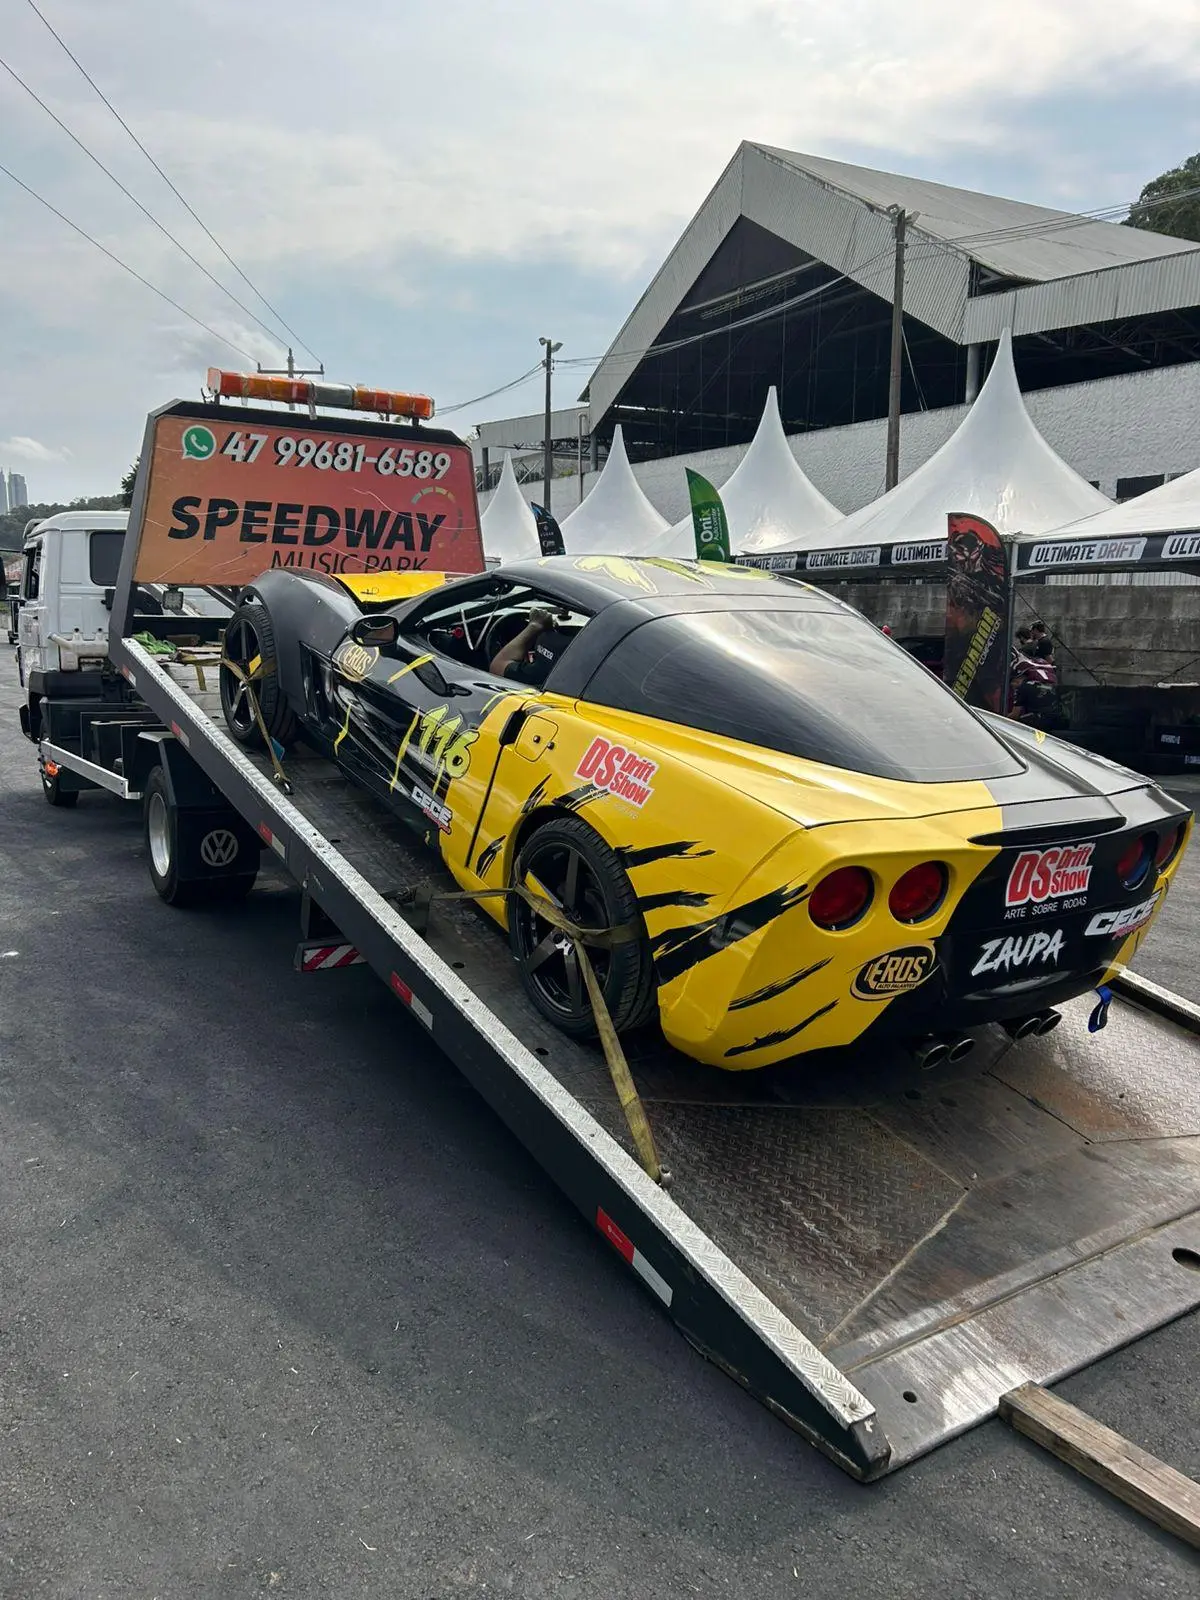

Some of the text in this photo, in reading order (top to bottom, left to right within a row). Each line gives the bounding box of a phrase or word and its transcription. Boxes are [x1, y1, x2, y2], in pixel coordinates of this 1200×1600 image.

[221, 431, 452, 481] 47 99681-6589
[167, 495, 447, 552] SPEEDWAY
[699, 508, 713, 542] Onix
[270, 550, 429, 574] MUSIC PARK
[771, 555, 797, 569] DRIFT
[809, 549, 877, 567] ULTIMATE DRIFT
[895, 544, 943, 561] ULTIMATE
[1034, 540, 1142, 563] ULTIMATE DRIFT
[419, 703, 480, 779] 116
[575, 735, 628, 788] DS
[619, 752, 657, 784] Drift
[608, 771, 652, 806] Show
[411, 785, 452, 828] CECE
[1055, 845, 1094, 870] Drift
[1006, 849, 1061, 904] DS
[1051, 868, 1090, 895] Show
[1004, 895, 1088, 920] ARTE SOBRE RODAS
[1084, 889, 1161, 937] CECE
[971, 928, 1068, 977] ZAUPA
[867, 954, 928, 990] EROS
